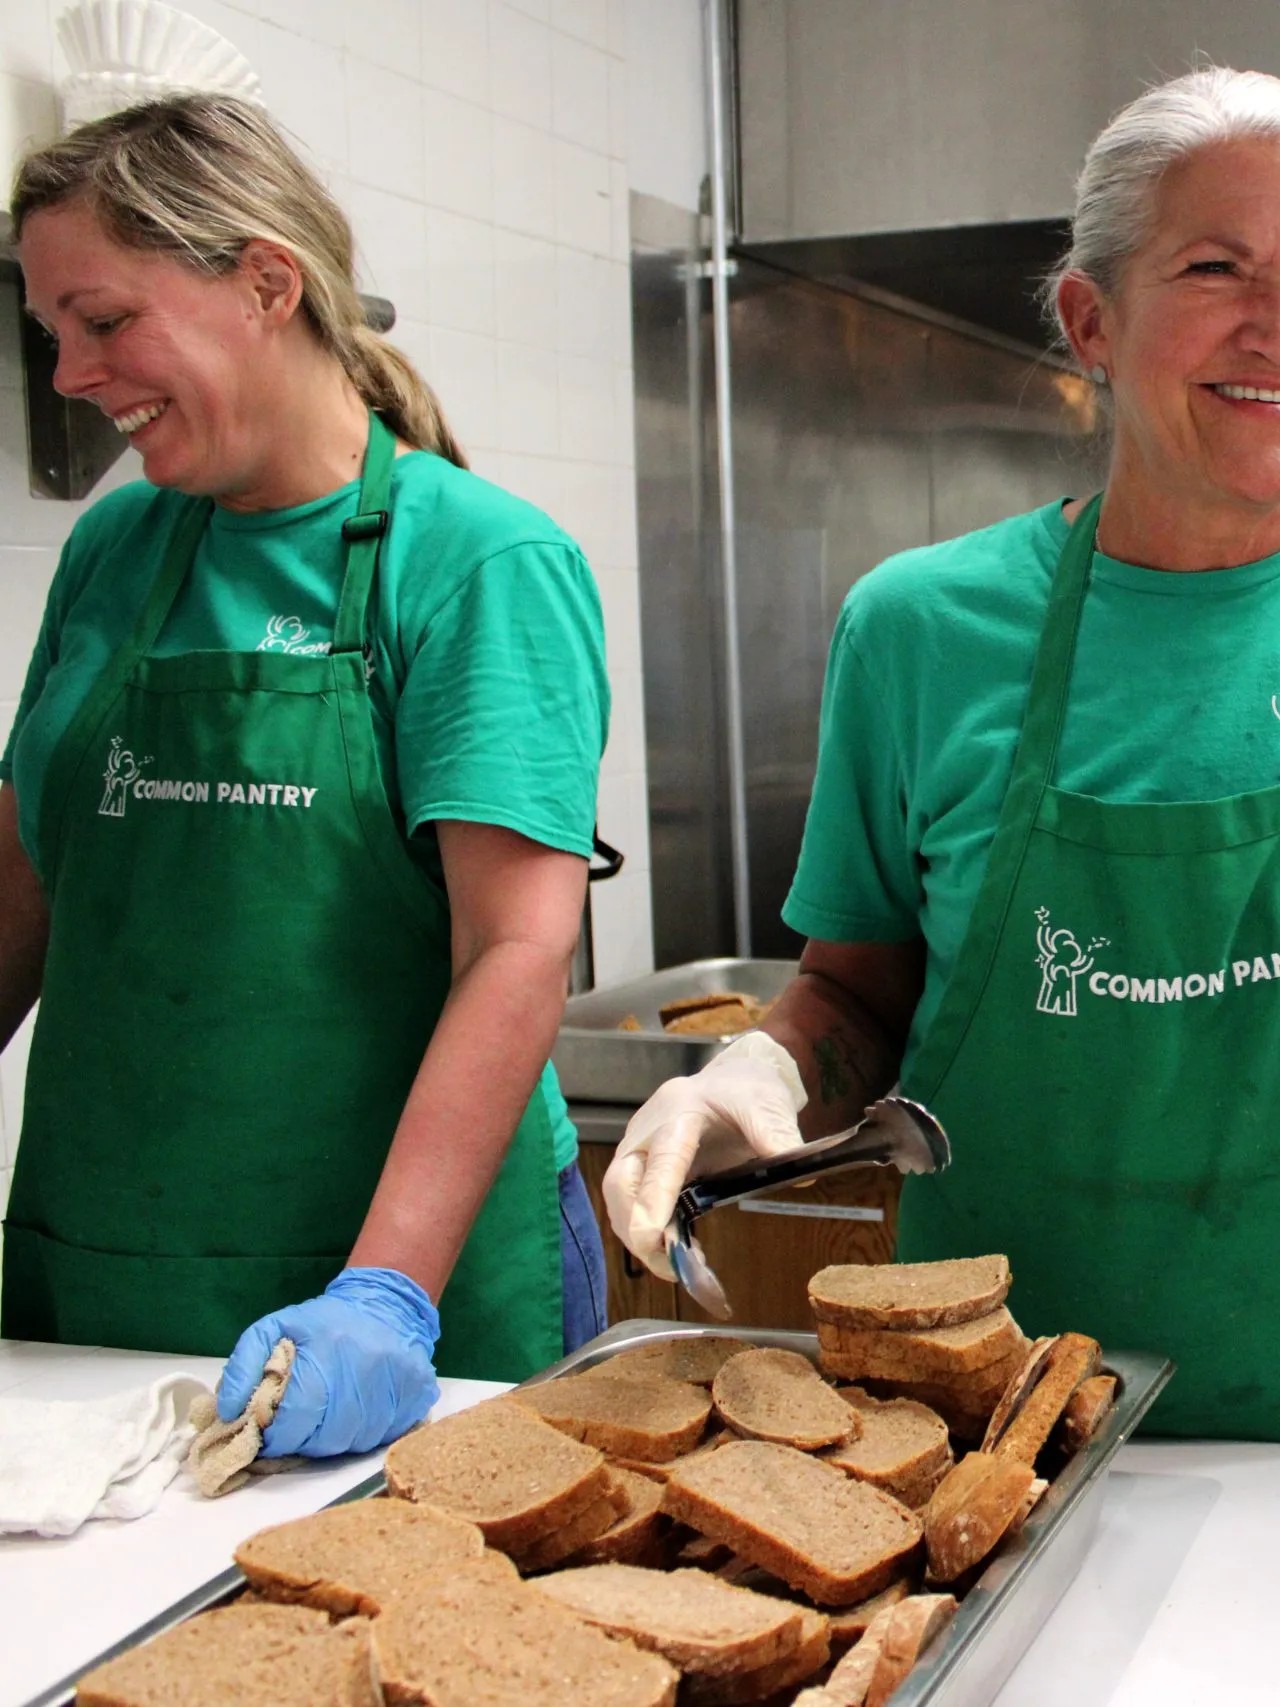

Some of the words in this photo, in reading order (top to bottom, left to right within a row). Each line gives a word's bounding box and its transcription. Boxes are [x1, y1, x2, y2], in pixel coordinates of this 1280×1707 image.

[133, 779, 209, 802] COMMON
[217, 782, 318, 808] PANTRY
[1089, 970, 1225, 1003] COMMON
